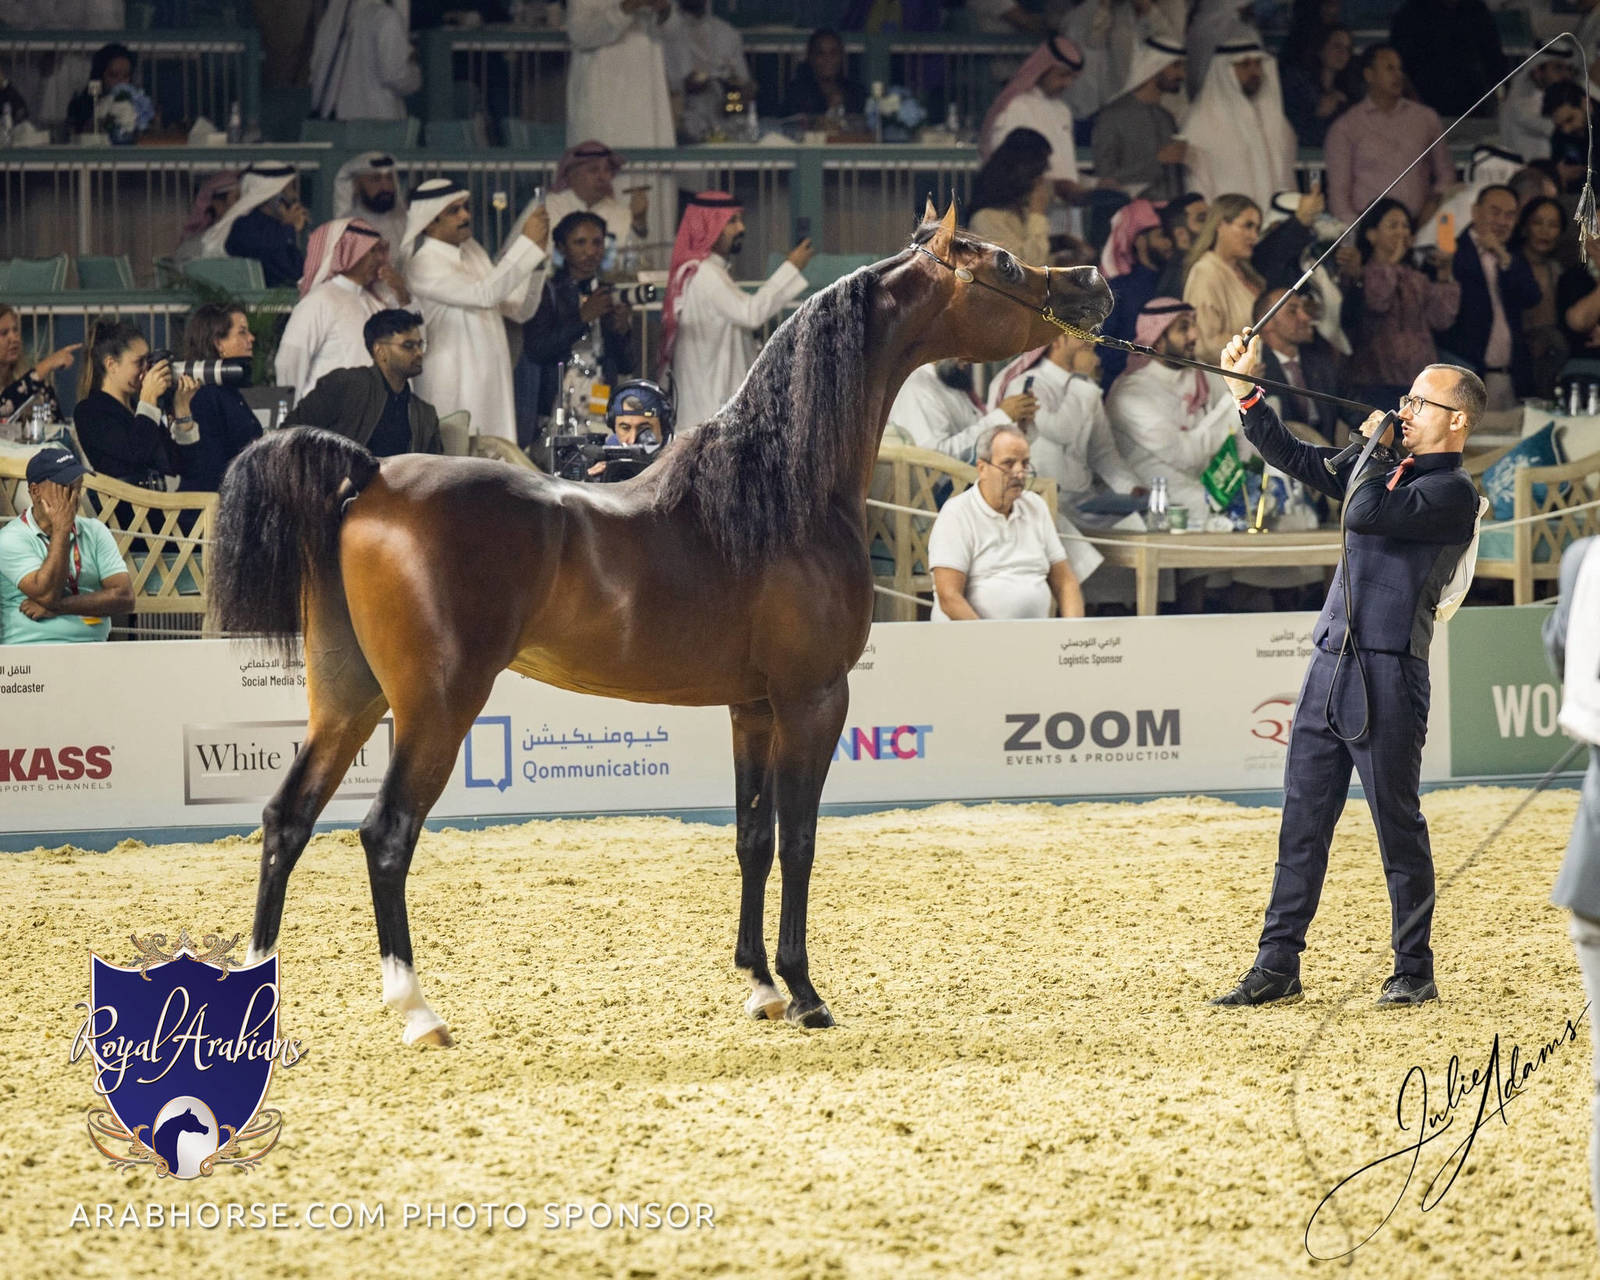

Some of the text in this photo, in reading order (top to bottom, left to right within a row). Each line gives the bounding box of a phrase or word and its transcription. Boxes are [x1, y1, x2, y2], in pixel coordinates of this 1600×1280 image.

[1256, 647, 1295, 658] Insurance
[1058, 653, 1124, 668] Logistic Sponsor
[0, 682, 45, 694] oadcaster
[241, 675, 268, 687] Social
[269, 675, 295, 686] Media
[1491, 683, 1566, 738] WO
[1004, 709, 1181, 751] ZOOM
[0, 745, 112, 782] KASS
[196, 742, 281, 772] White
[1006, 751, 1180, 765] EVENTS & PRODUCTION
[522, 757, 669, 783] Qommunication
[47, 781, 112, 791] CHANNELS
